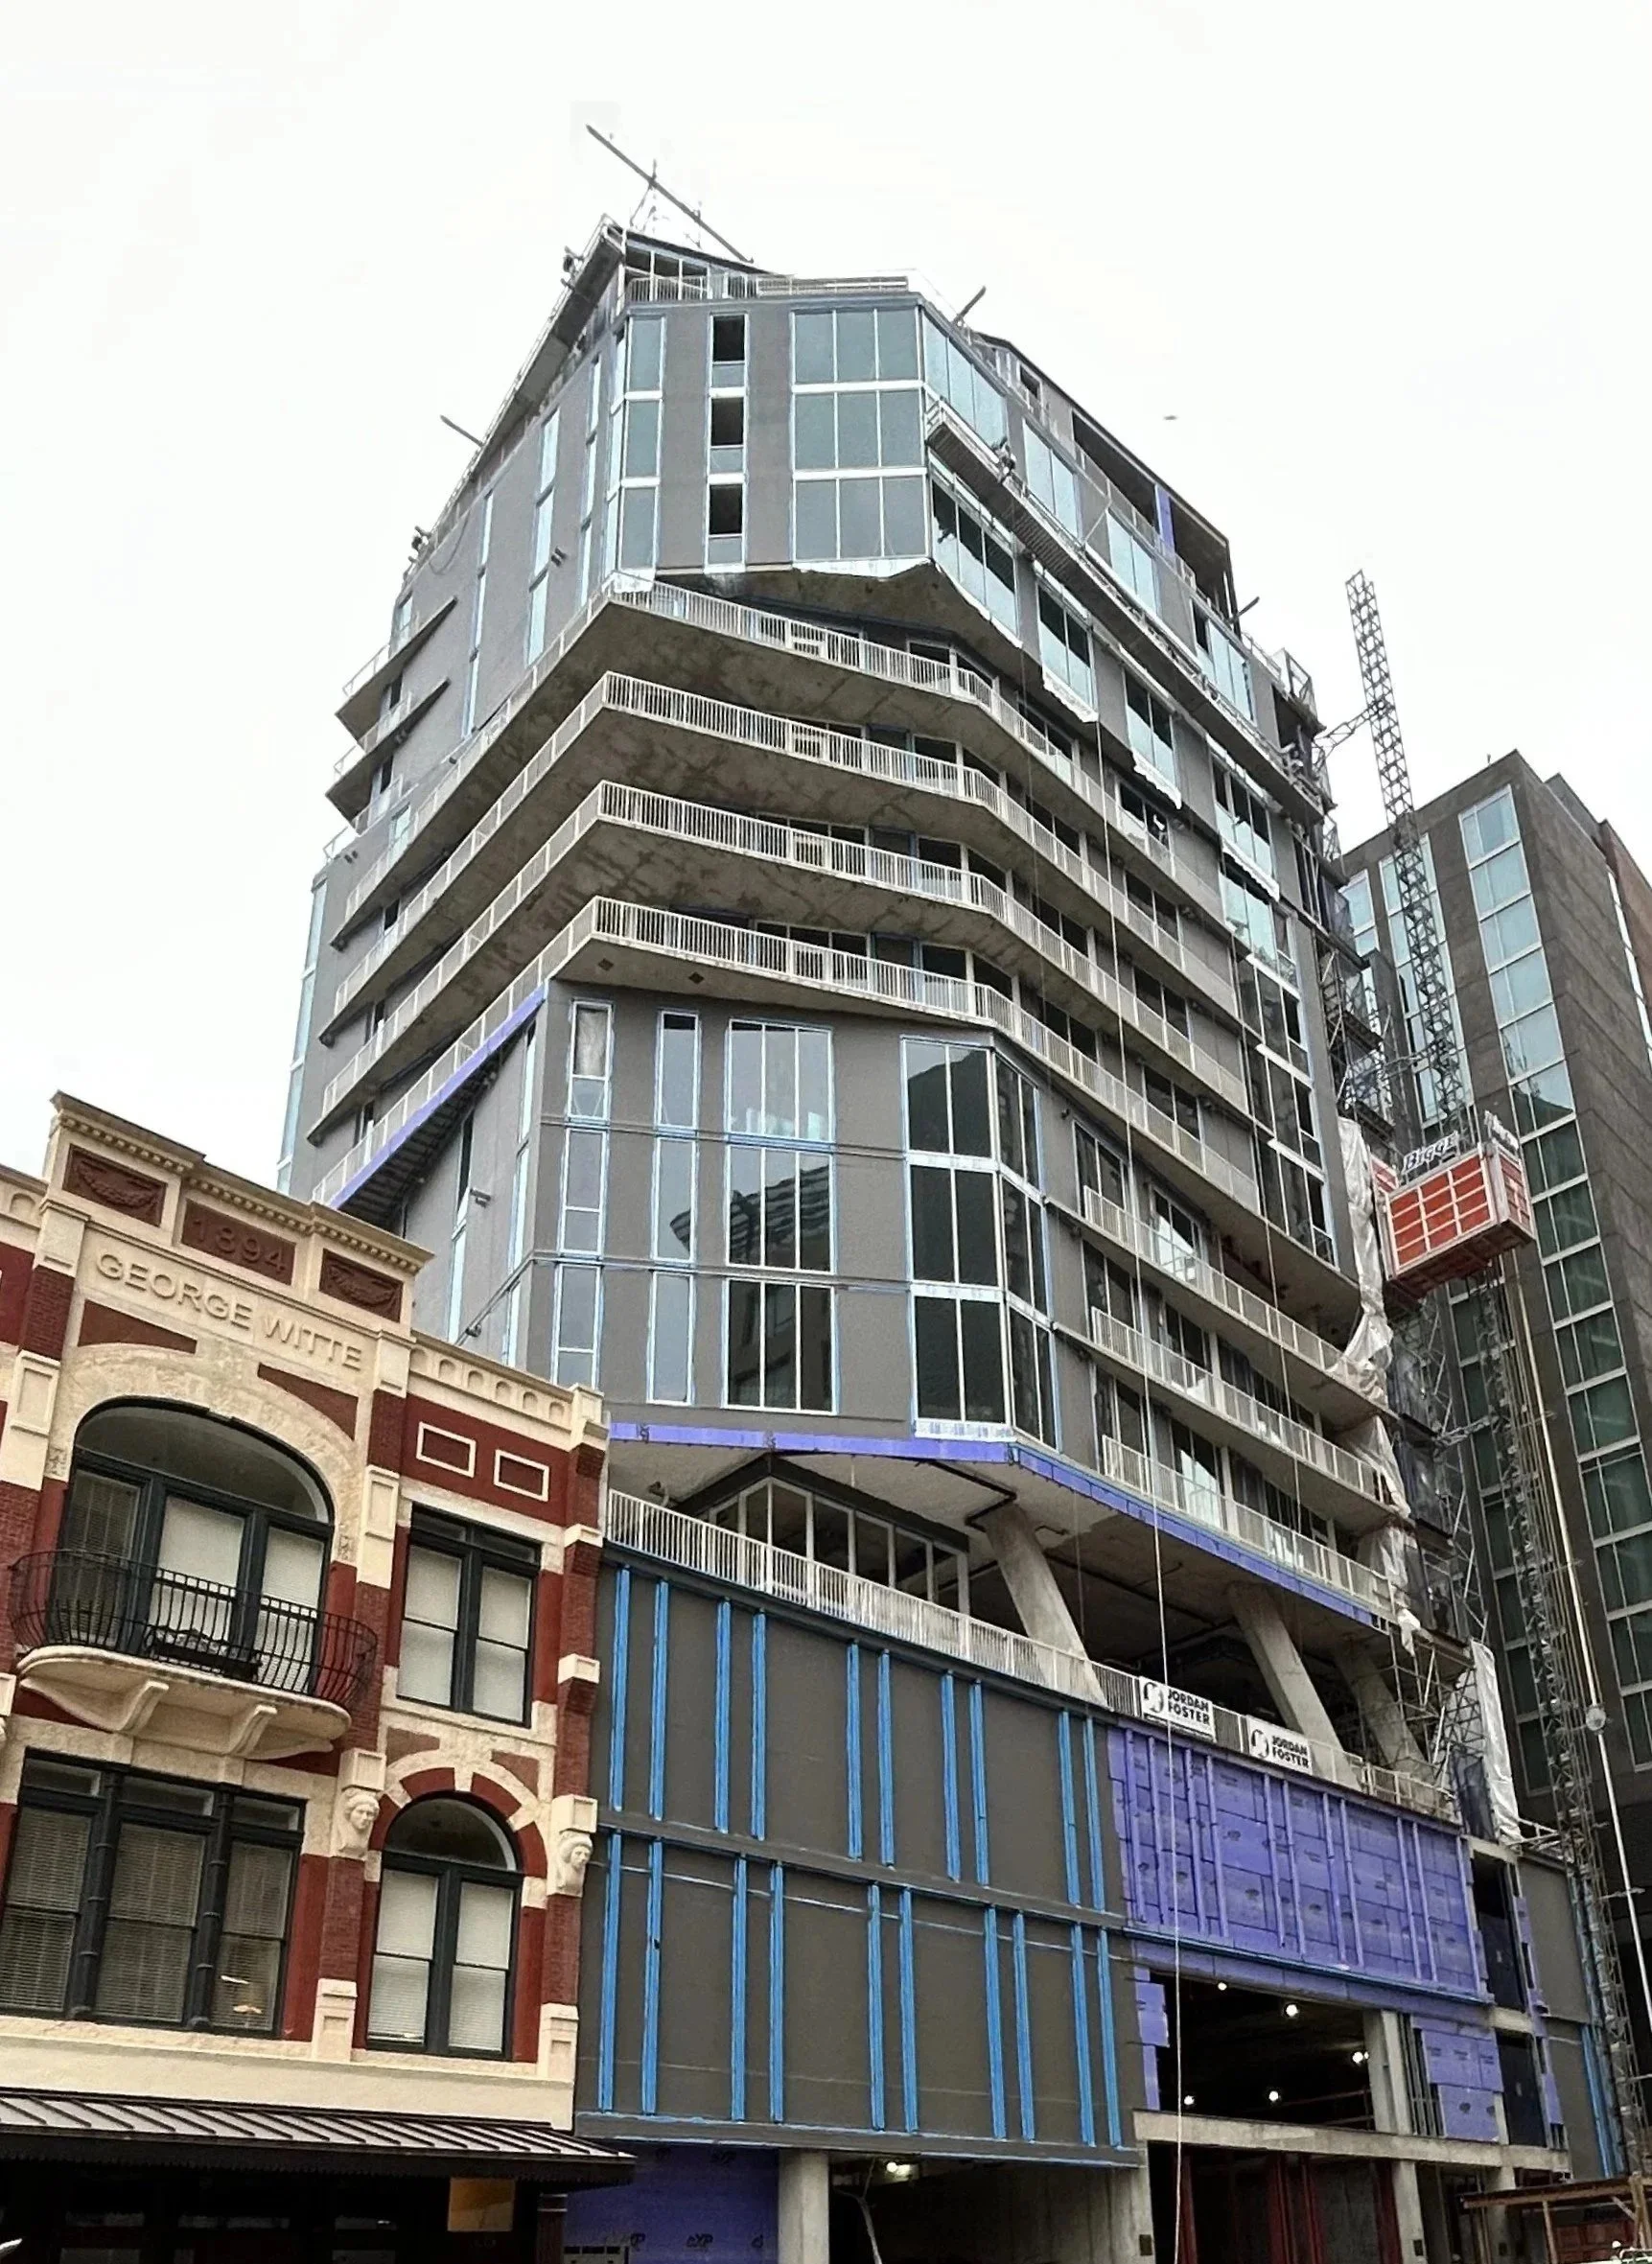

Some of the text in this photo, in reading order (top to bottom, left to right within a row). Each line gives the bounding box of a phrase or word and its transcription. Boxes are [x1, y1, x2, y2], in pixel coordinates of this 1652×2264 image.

[193, 1216, 286, 1273] 1894
[97, 1253, 362, 1371] GEORGE WITTE
[1168, 1689, 1209, 1714] JORDAN
[1168, 1701, 1211, 1726] FOSTER
[1272, 1736, 1308, 1756] JORDAN
[1272, 1746, 1309, 1768] FOSTER
